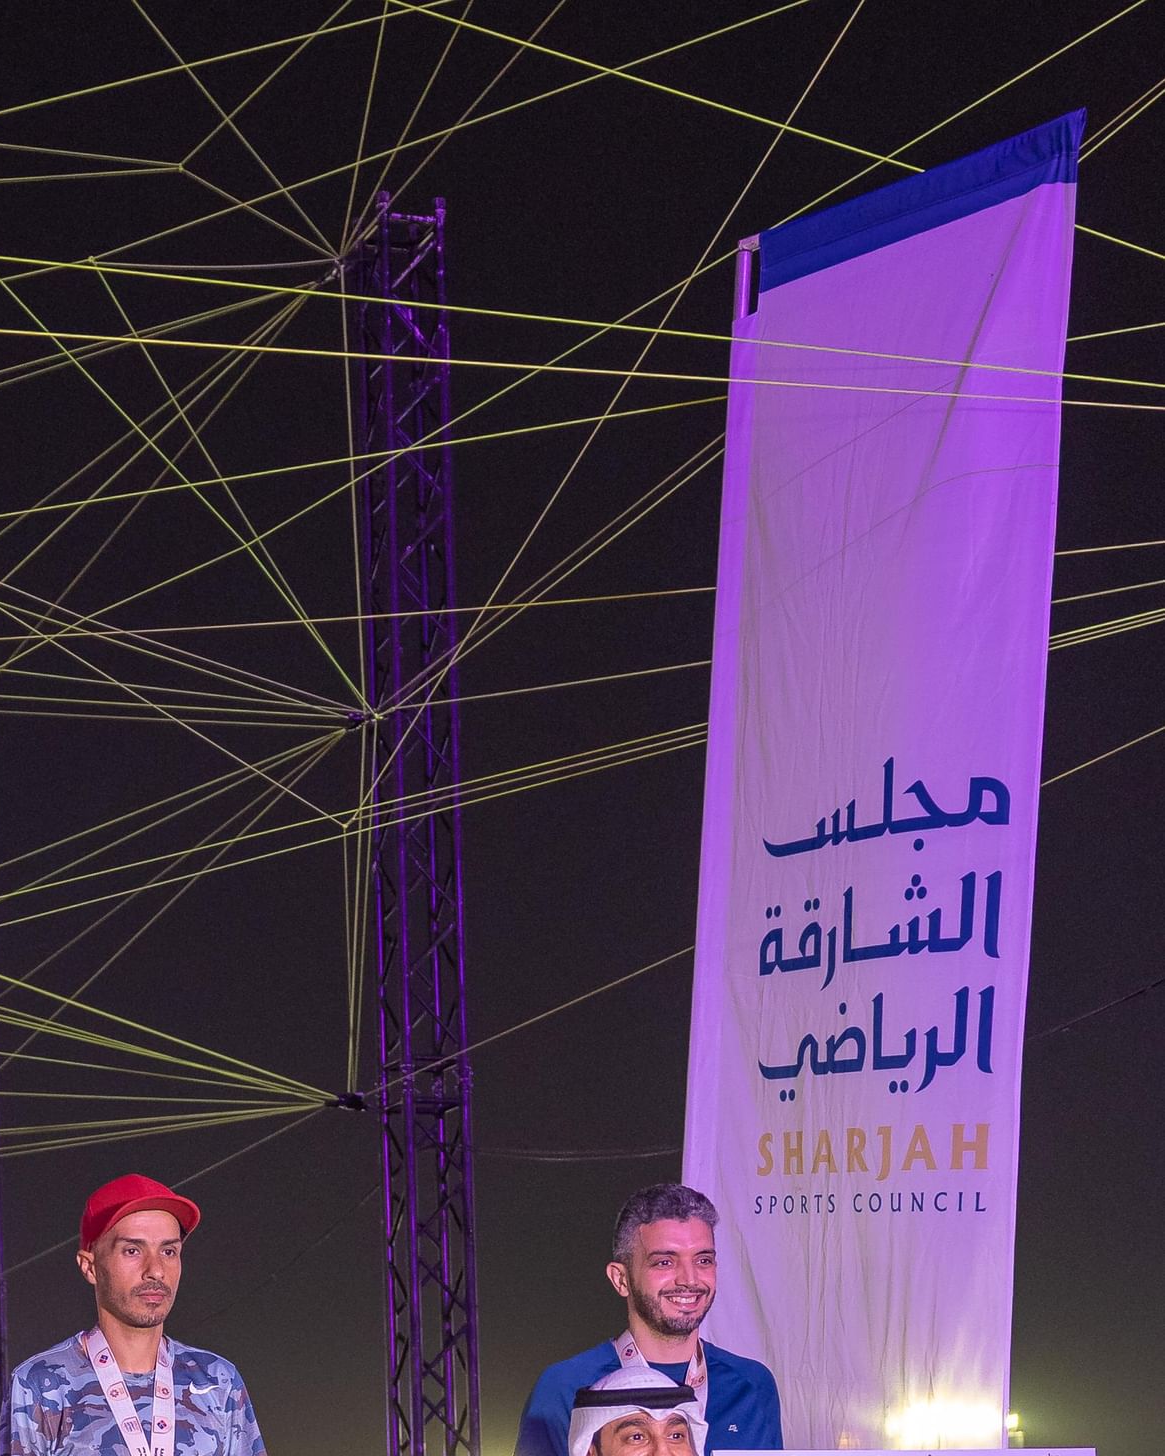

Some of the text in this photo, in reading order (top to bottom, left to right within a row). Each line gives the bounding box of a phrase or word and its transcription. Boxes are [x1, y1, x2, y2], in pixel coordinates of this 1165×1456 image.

[763, 756, 1010, 857] مجلس
[758, 870, 1002, 991] الشارقة
[758, 985, 995, 1101] الرياضي
[755, 1123, 991, 1181] SHARJAH
[754, 1192, 987, 1214] SPORTS COUNCIL
